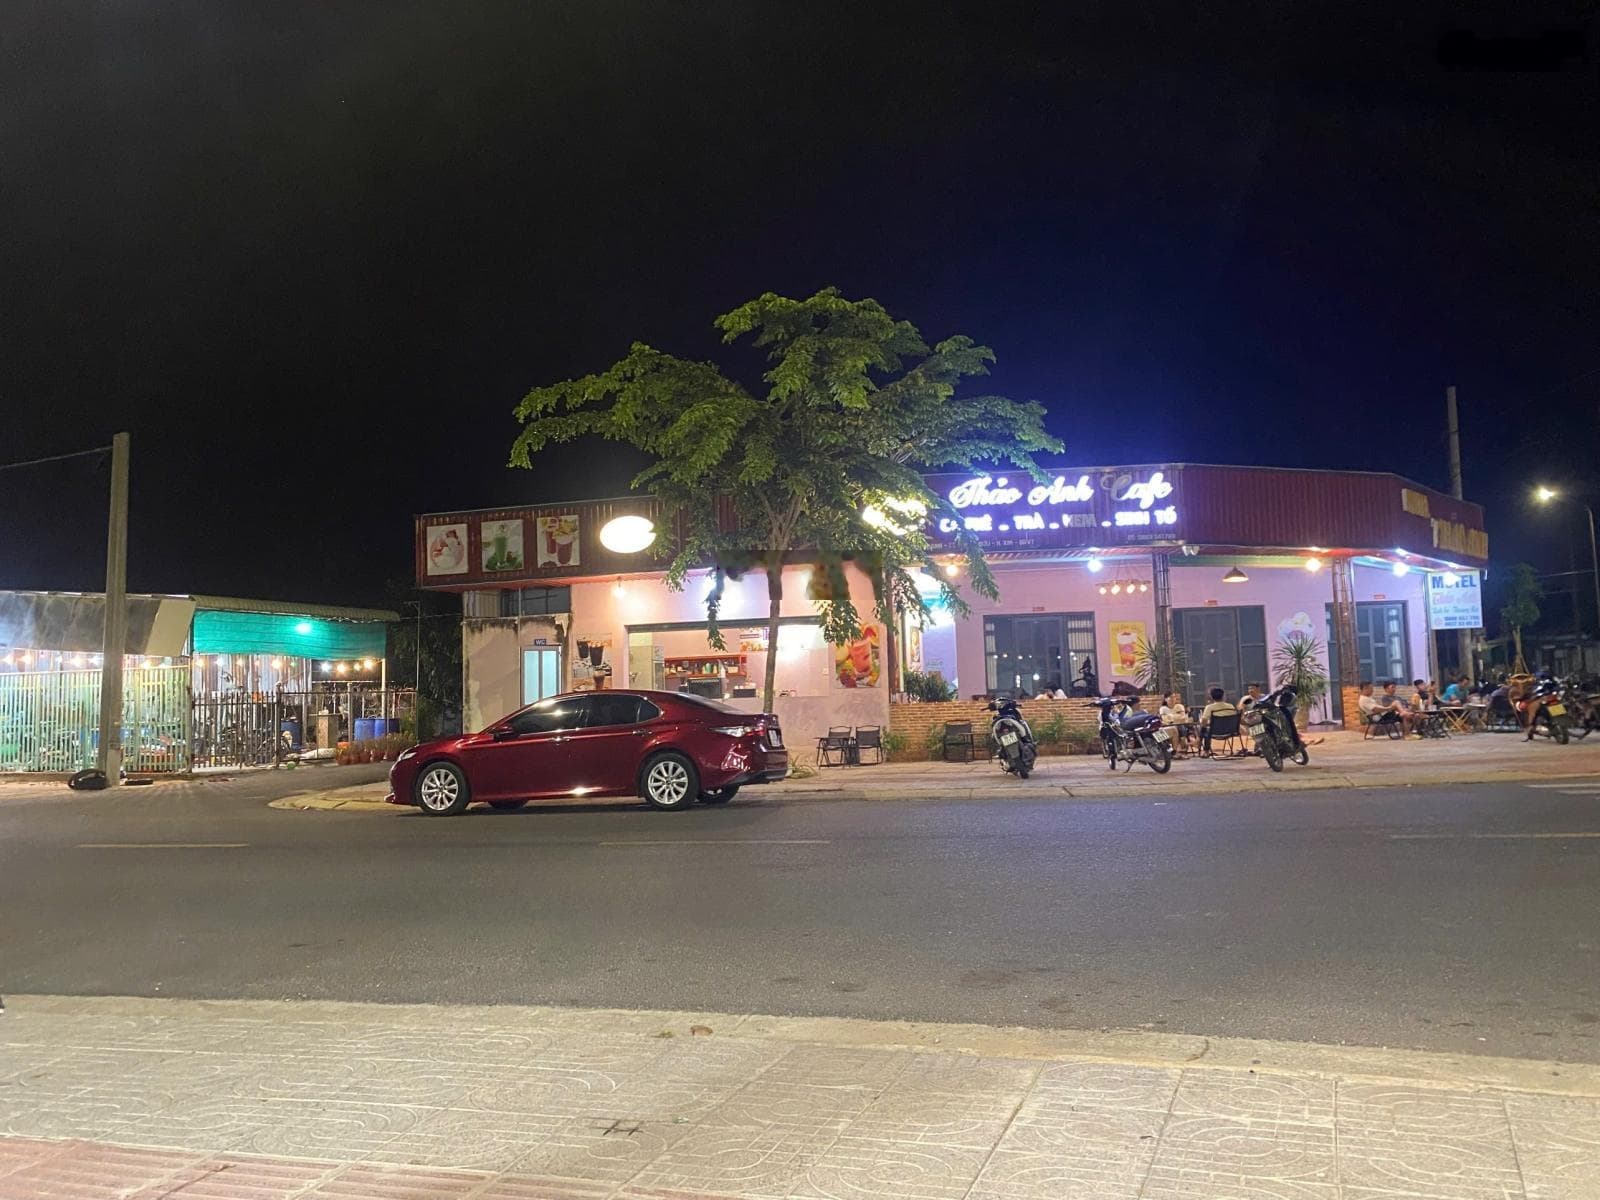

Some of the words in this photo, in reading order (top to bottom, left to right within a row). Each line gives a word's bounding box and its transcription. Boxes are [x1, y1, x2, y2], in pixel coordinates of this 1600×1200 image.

[1027, 475, 1094, 506] Anh
[1100, 472, 1174, 509] Cafe
[1013, 511, 1046, 530] TRÀ
[1061, 513, 1098, 528] KEM
